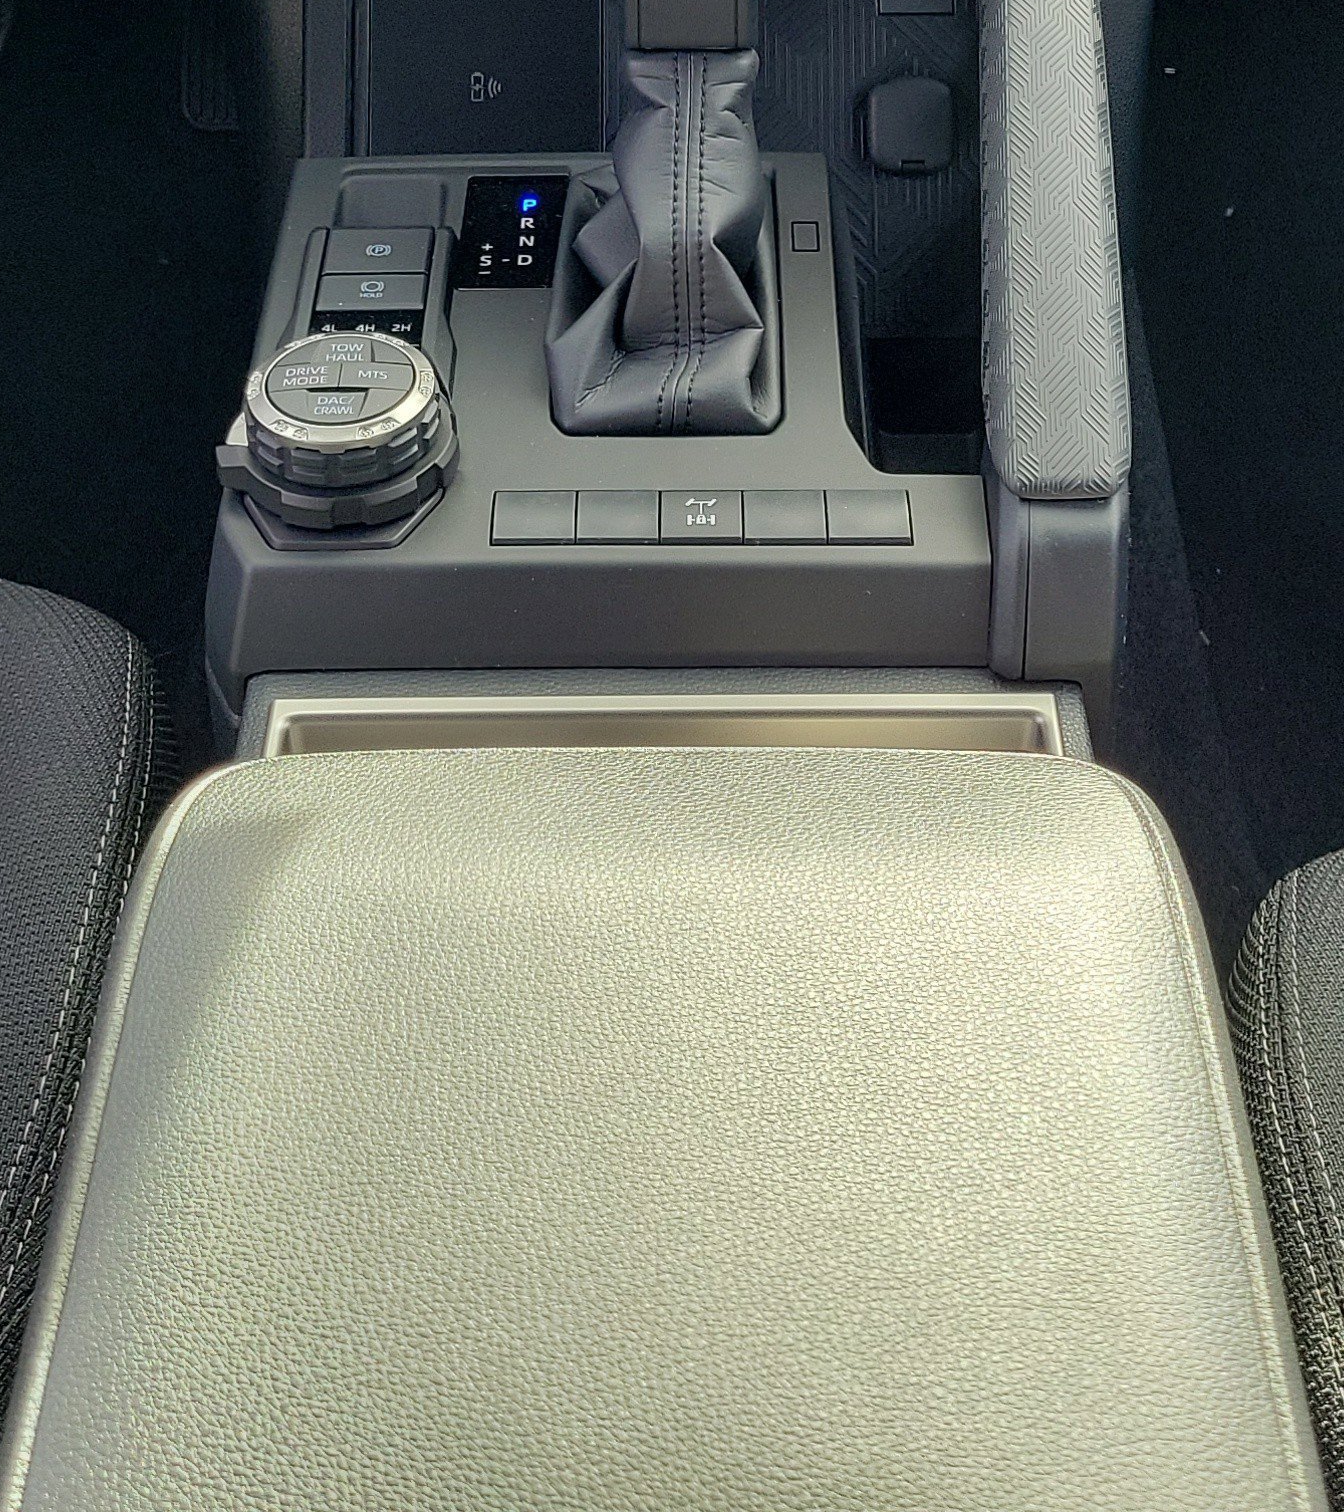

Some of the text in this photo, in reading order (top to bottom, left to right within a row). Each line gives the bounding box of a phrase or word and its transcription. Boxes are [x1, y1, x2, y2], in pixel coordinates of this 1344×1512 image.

[523, 199, 537, 211] P
[520, 217, 536, 229] R
[519, 236, 535, 247] N
[479, 255, 533, 266] S D
[321, 323, 411, 332] 4L 4H 2H
[330, 343, 364, 352] TOW
[325, 353, 365, 362] HAUL
[285, 366, 328, 377] DRIVE
[357, 369, 388, 380] MTS
[282, 375, 327, 387] MODE
[316, 396, 355, 405] DAC/
[313, 406, 355, 415] CRAWL
